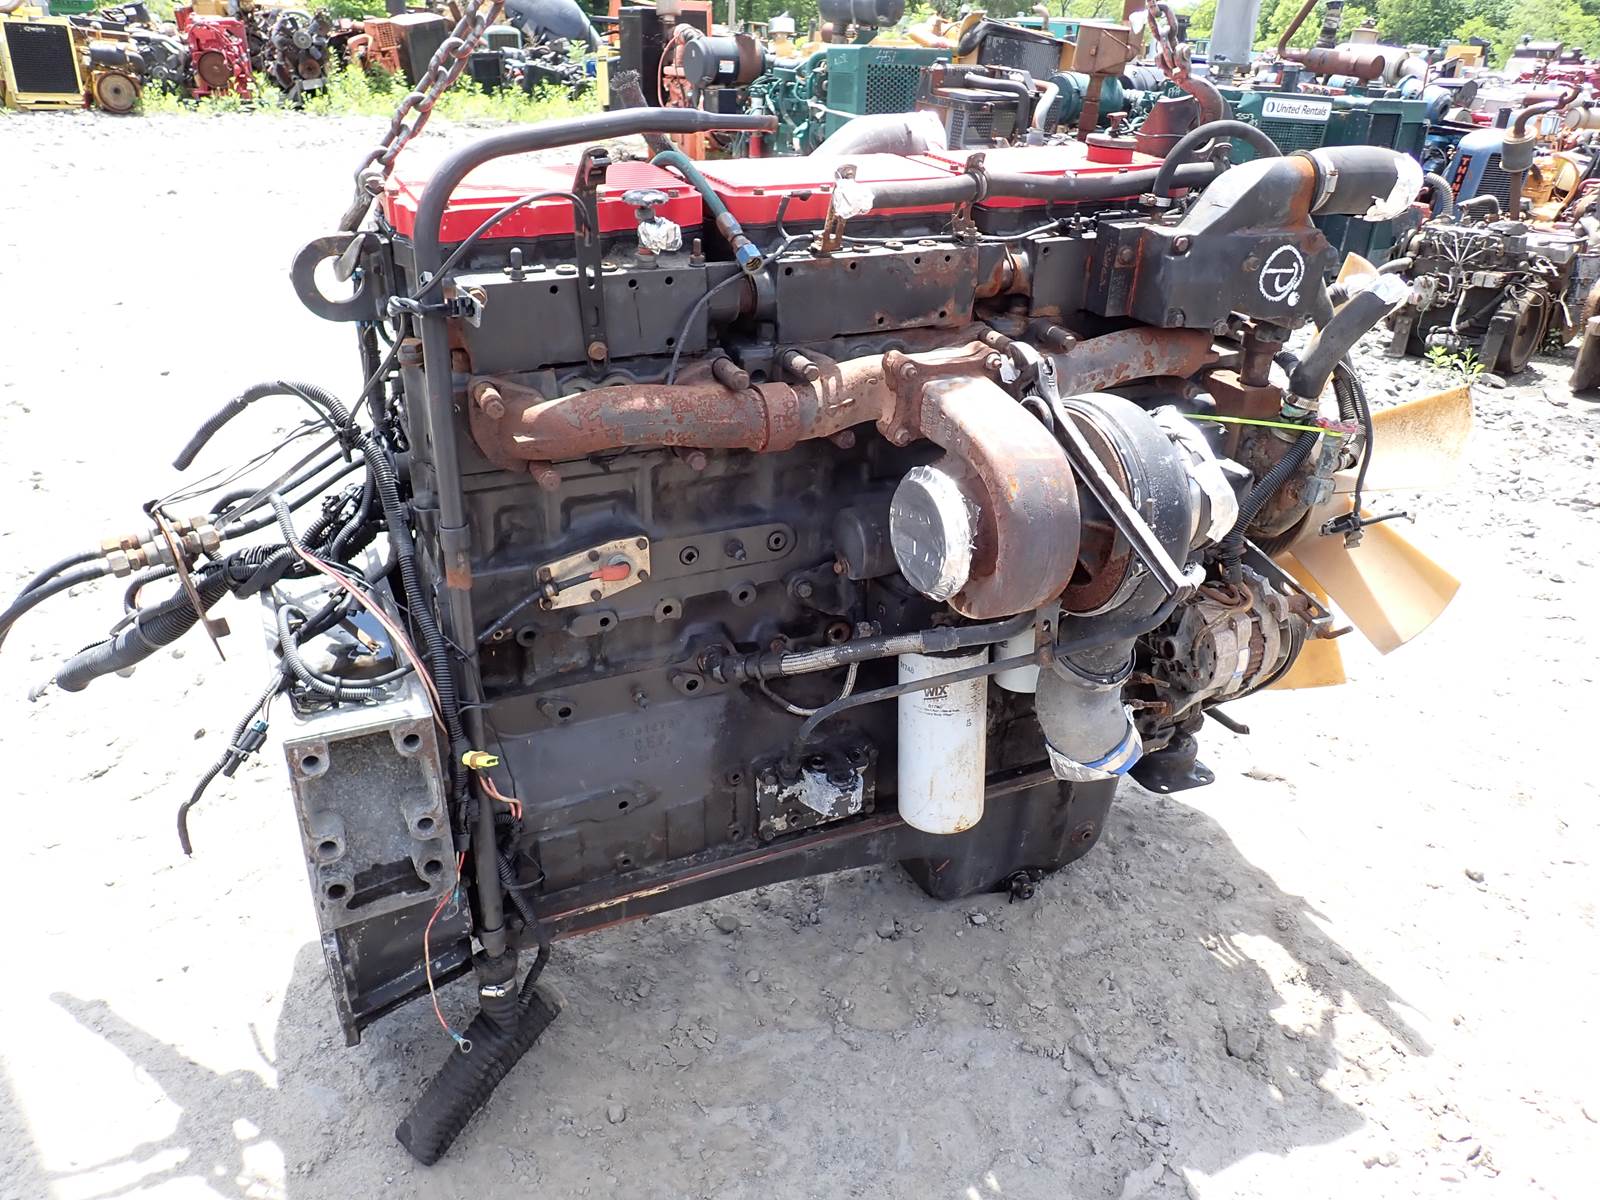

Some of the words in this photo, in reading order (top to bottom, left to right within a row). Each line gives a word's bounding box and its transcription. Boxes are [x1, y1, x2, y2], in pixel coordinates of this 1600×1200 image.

[1276, 102, 1301, 114] United
[1301, 105, 1327, 116] Rentals
[924, 685, 949, 697] WIX
